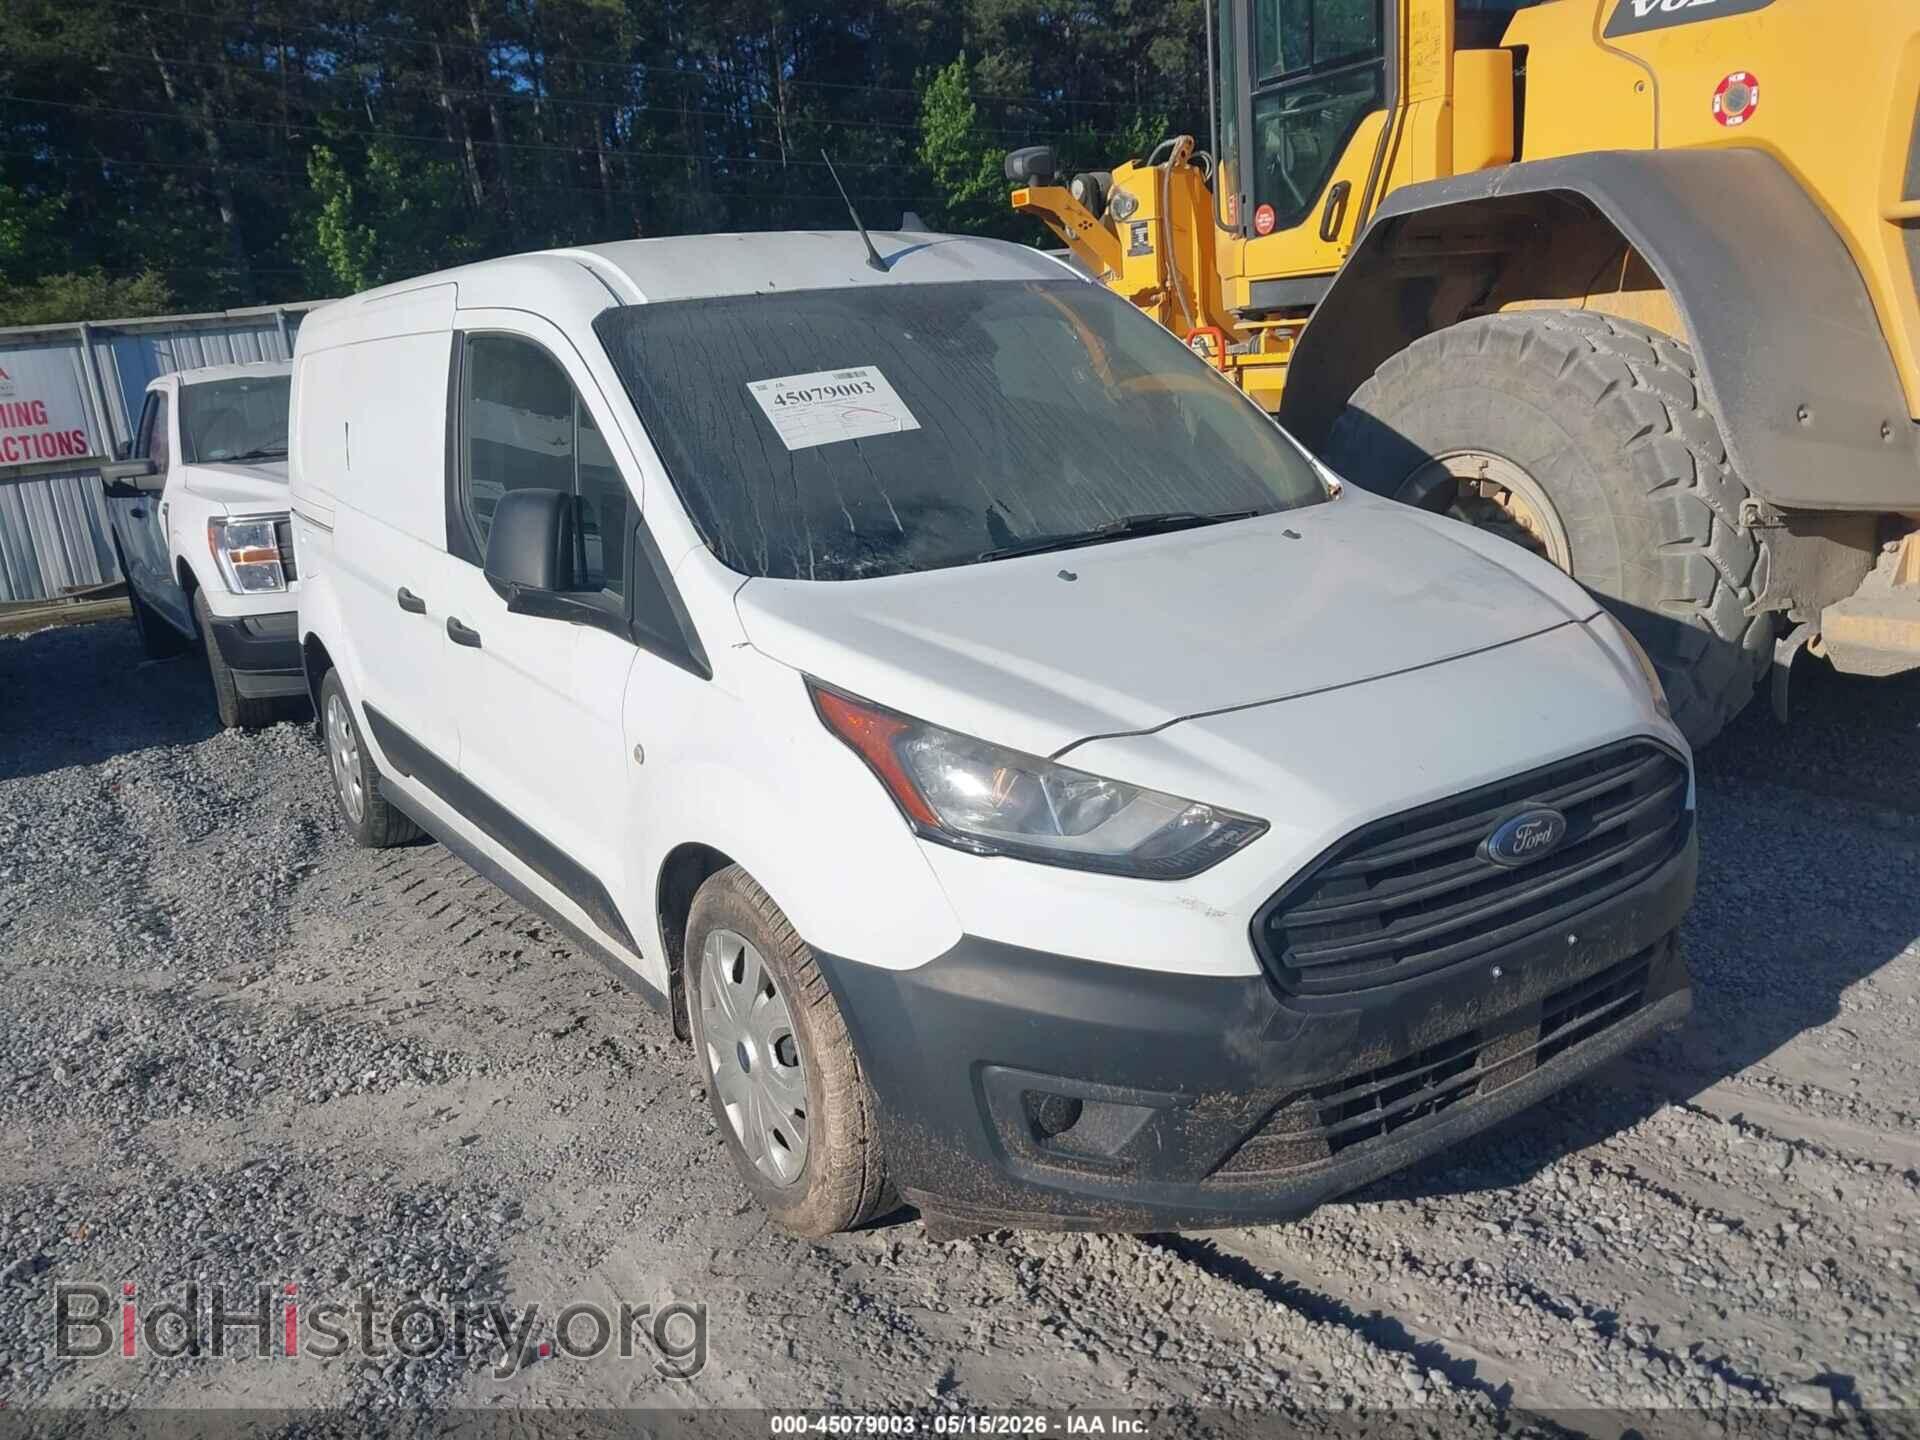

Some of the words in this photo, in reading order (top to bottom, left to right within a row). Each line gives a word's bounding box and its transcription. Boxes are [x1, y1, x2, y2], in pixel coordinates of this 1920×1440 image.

[774, 381, 876, 406] 45079003
[0, 429, 88, 462] CTIONS
[1512, 820, 1554, 854] Ford
